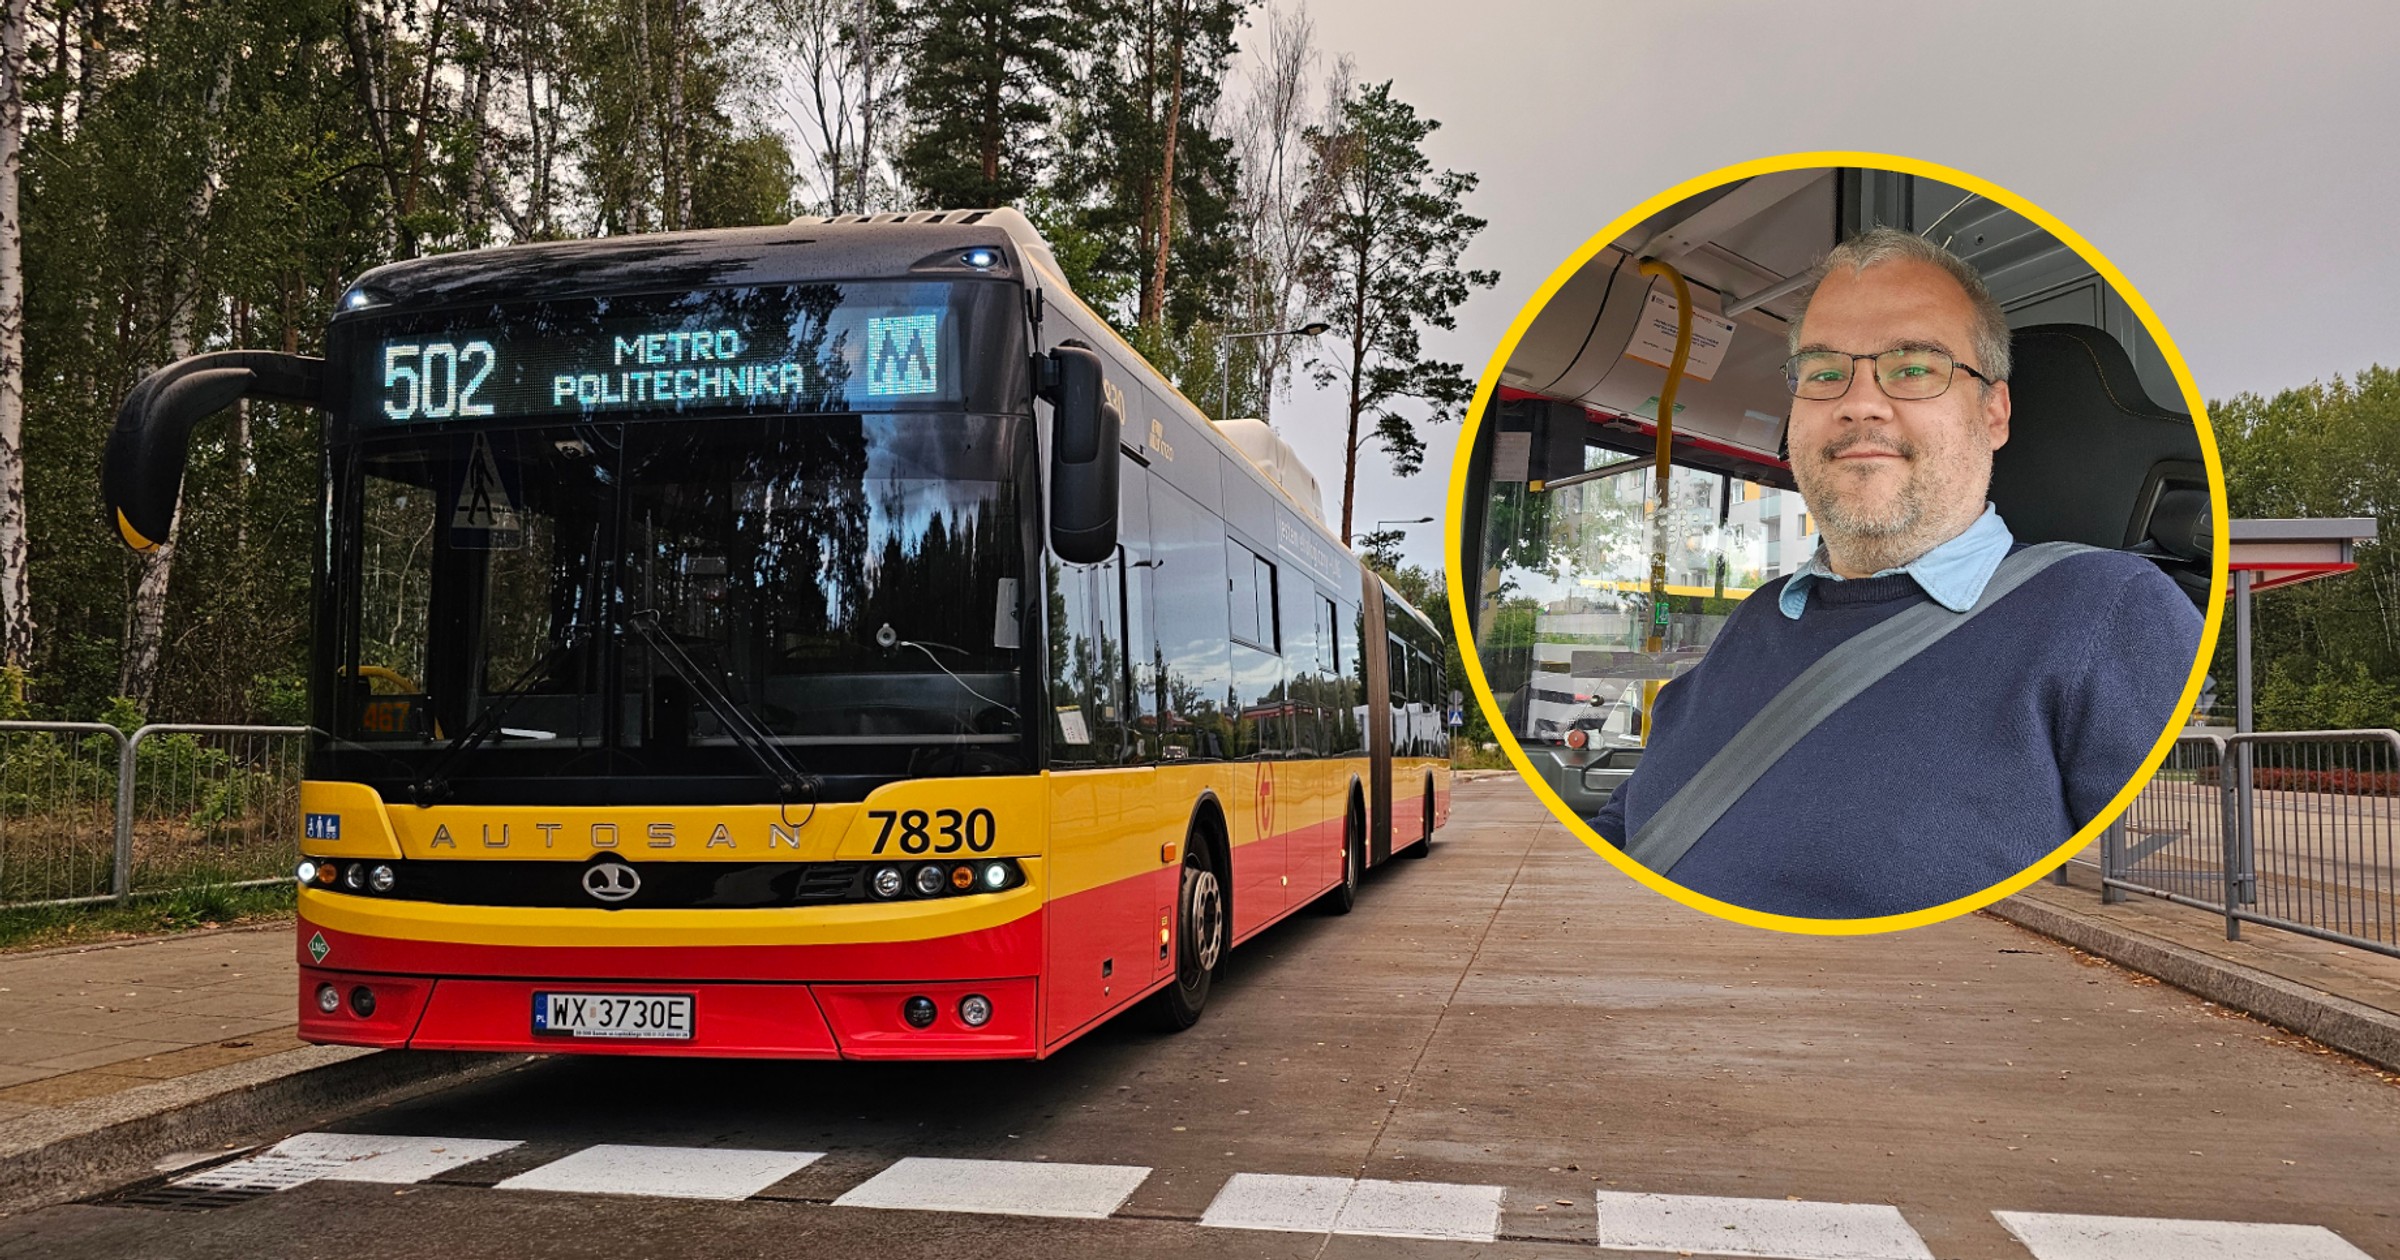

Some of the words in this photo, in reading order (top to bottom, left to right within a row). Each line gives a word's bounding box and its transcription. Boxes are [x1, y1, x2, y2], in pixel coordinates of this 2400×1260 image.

[614, 329, 738, 366] METRO
[382, 342, 495, 420] 502
[554, 363, 802, 405] POLITECHNIKA
[364, 703, 410, 731] 467
[431, 823, 801, 849] AUTOSAN
[867, 808, 996, 854] 7830
[311, 941, 326, 953] LNG
[536, 1014, 546, 1023] PL
[553, 997, 587, 1027] WX
[598, 998, 685, 1030] 3730E
